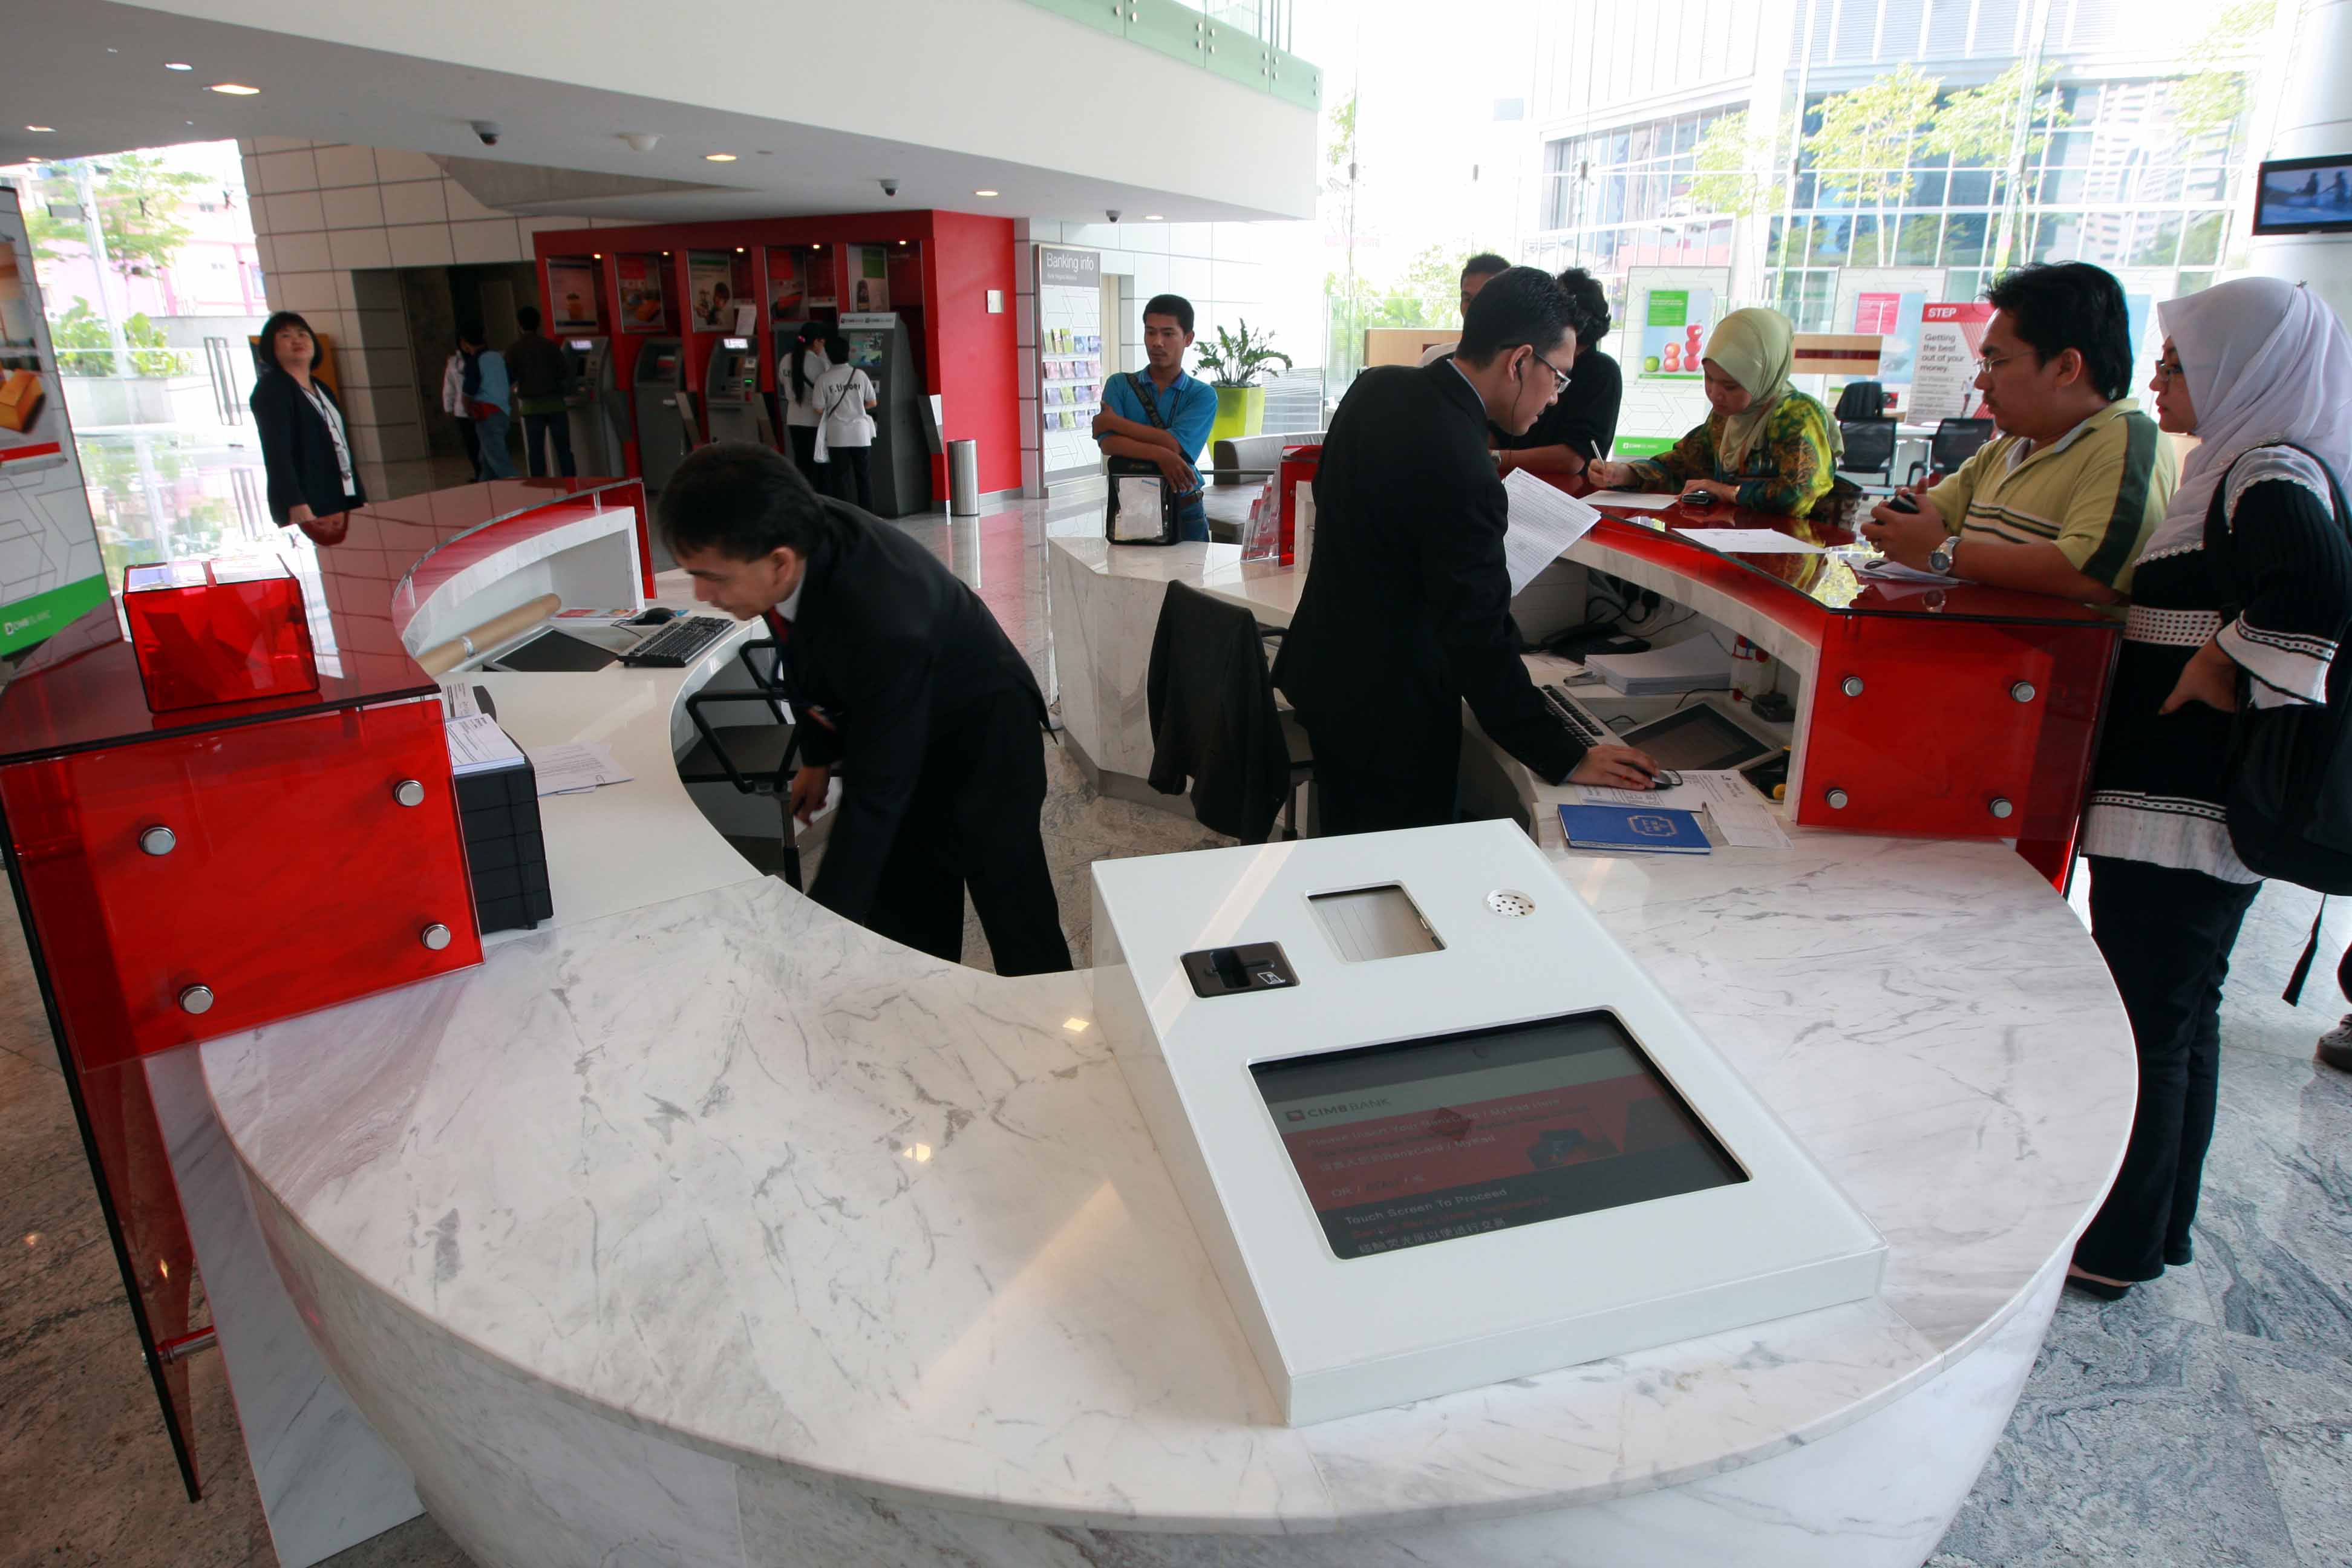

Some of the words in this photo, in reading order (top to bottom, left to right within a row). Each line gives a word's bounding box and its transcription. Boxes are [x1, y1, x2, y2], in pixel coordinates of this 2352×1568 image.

[1047, 252, 1079, 273] Banking
[1080, 256, 1094, 271] info
[1927, 307, 1958, 318] STEP
[1925, 333, 1956, 342] Getting
[1947, 355, 1965, 364] your
[1344, 1211, 1385, 1226] Touch
[1387, 1202, 1434, 1218] Screen
[1435, 1198, 1452, 1208] To
[1455, 1187, 1508, 1204] Proceed
